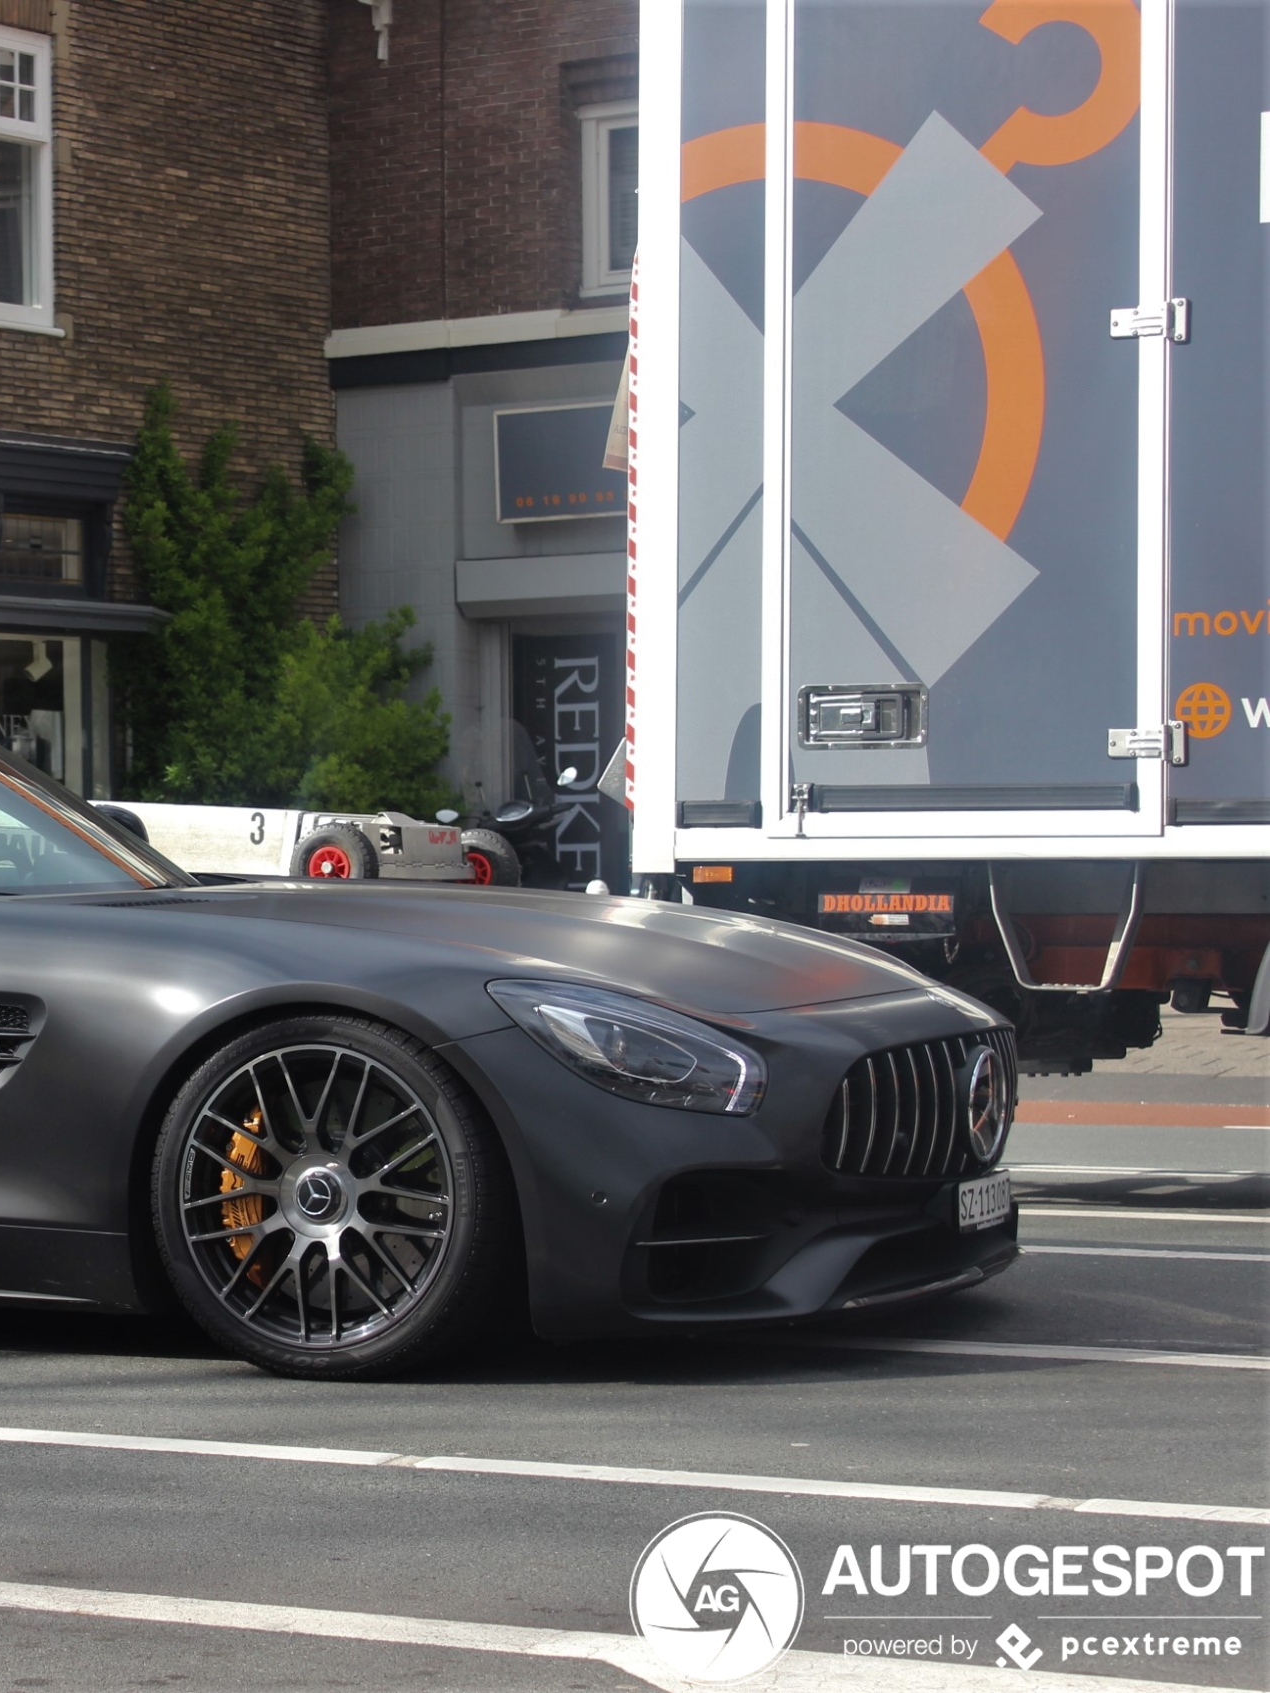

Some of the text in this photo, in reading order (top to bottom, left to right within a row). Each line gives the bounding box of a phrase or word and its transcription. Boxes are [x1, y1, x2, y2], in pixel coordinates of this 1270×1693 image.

[553, 655, 602, 888] REDKE
[250, 812, 265, 845] 3
[823, 894, 951, 912] DHOLLANDIA
